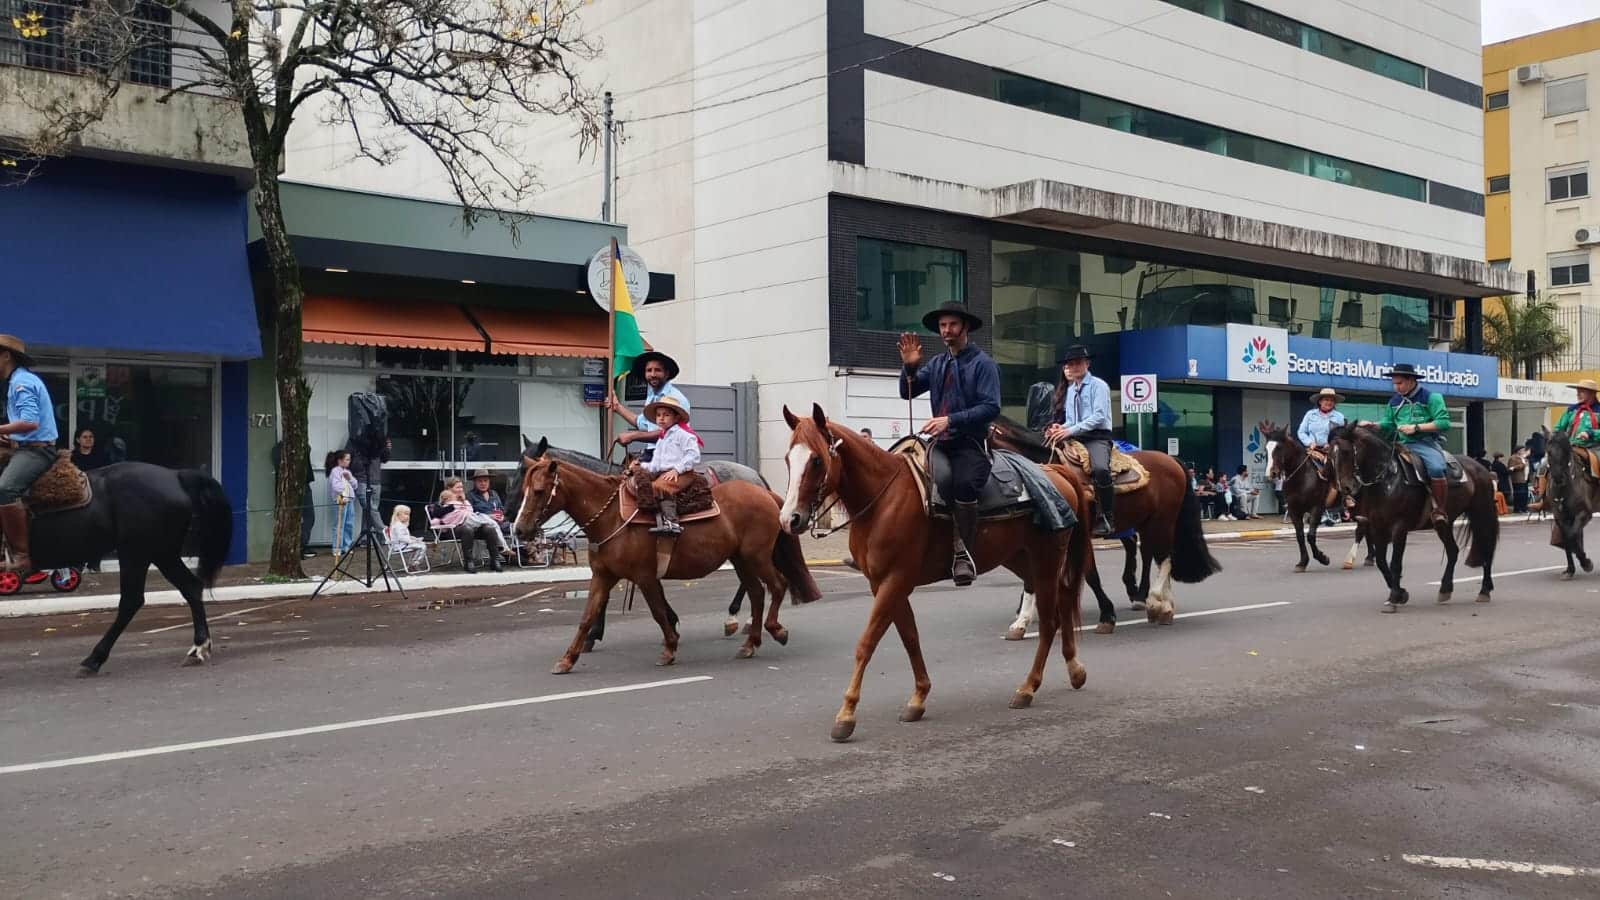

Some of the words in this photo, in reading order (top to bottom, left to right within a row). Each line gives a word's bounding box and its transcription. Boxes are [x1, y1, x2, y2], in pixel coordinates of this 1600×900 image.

[1287, 353, 1358, 377] Secretaria
[1427, 365, 1479, 387] Educação
[1133, 381, 1144, 398] E
[1124, 403, 1153, 413] MOTOS
